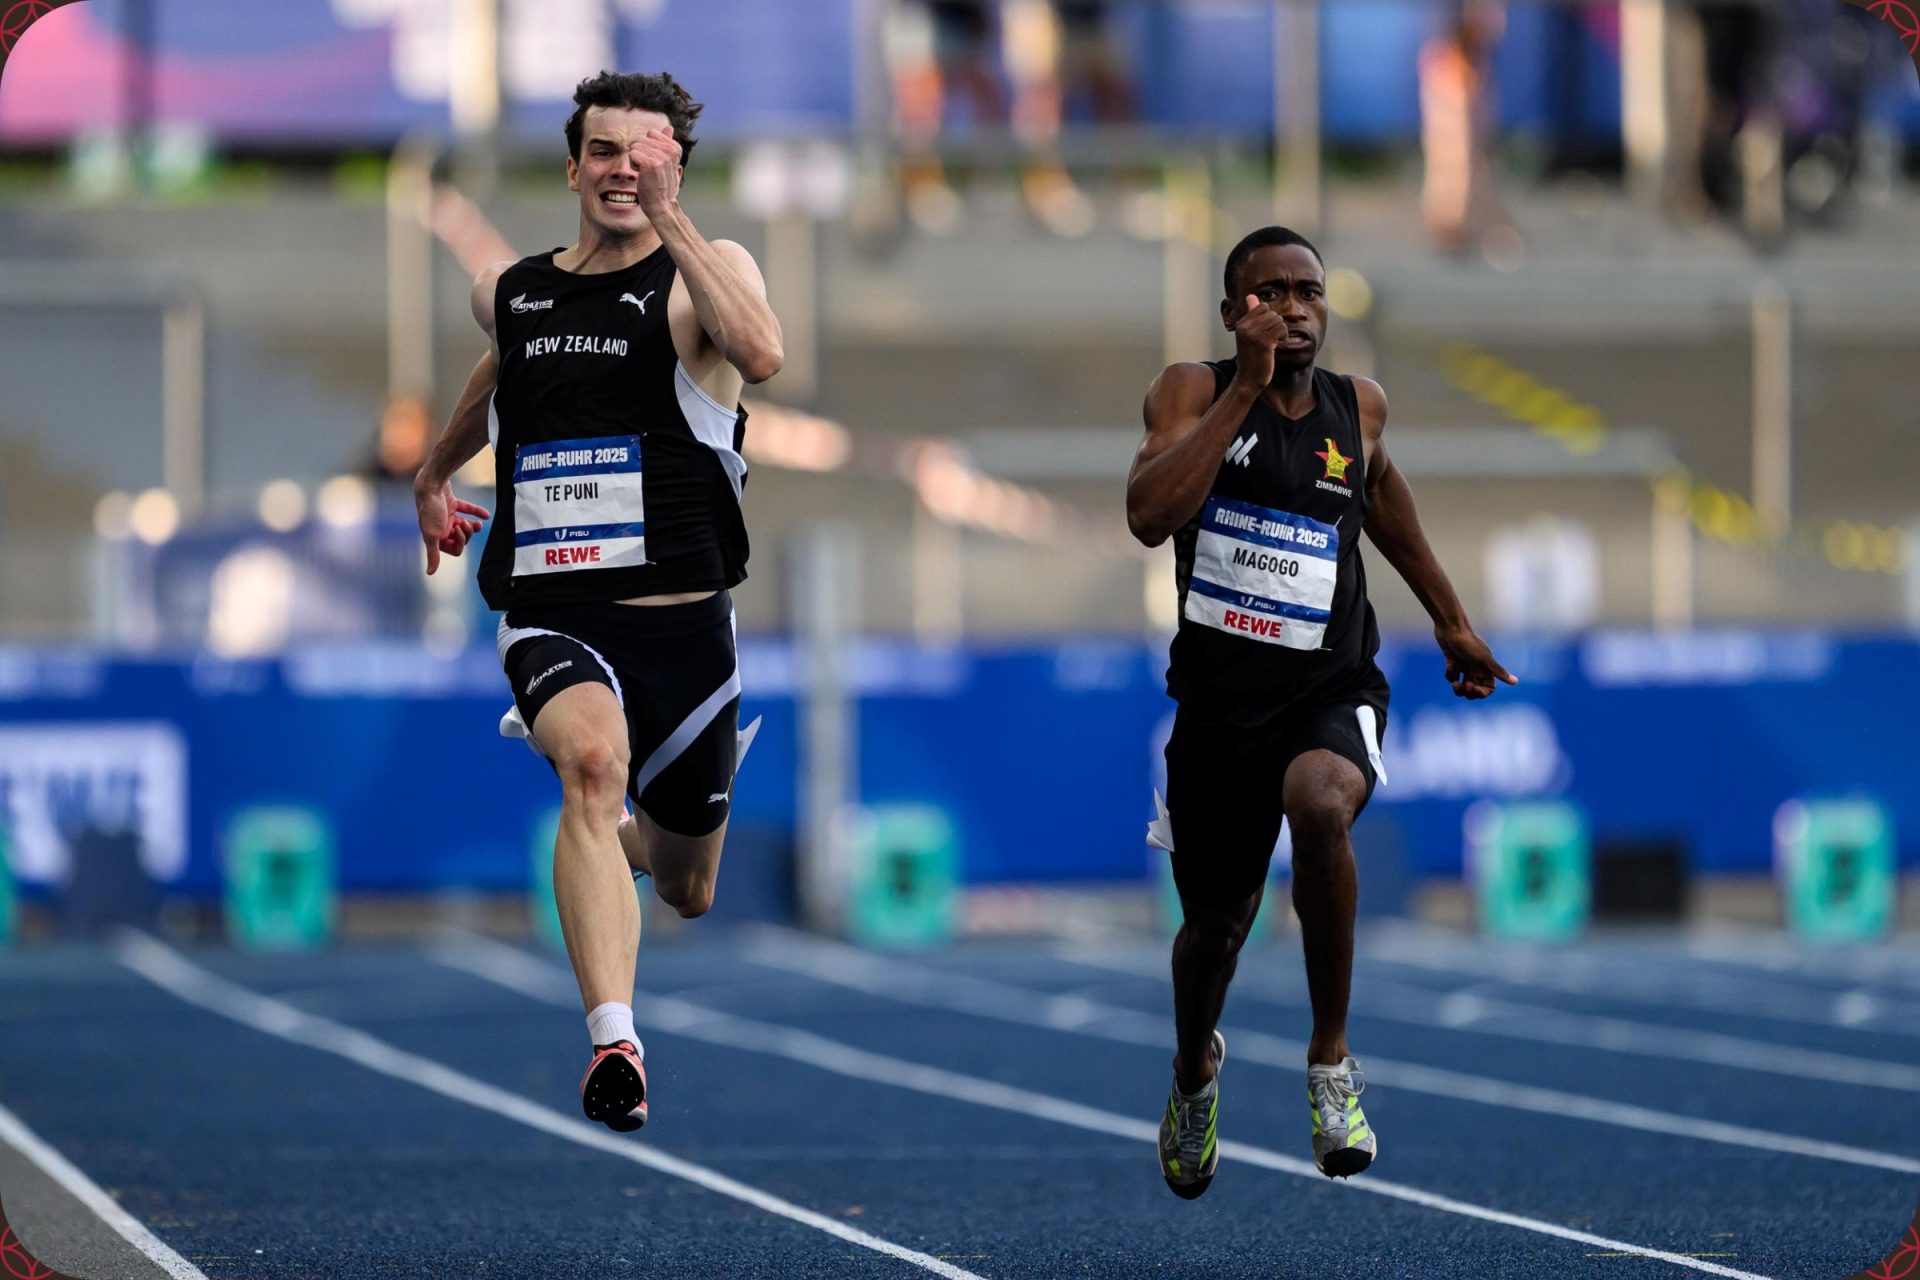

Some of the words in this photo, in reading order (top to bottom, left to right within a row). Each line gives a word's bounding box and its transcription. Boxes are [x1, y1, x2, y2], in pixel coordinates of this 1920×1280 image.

[526, 336, 561, 358] NEW
[564, 336, 628, 357] ZEALAND
[521, 449, 593, 472] RHINE-RUHR
[594, 447, 629, 464] 2025
[545, 485, 561, 502] TE
[564, 482, 599, 501] PUNI
[1315, 479, 1353, 498] ZIMBABWE
[1214, 507, 1295, 542] RHINE-RUHR
[1295, 527, 1330, 549] 2025
[545, 545, 601, 566] REWE
[1233, 547, 1299, 577] MAGOGO
[1223, 610, 1283, 639] REWE
